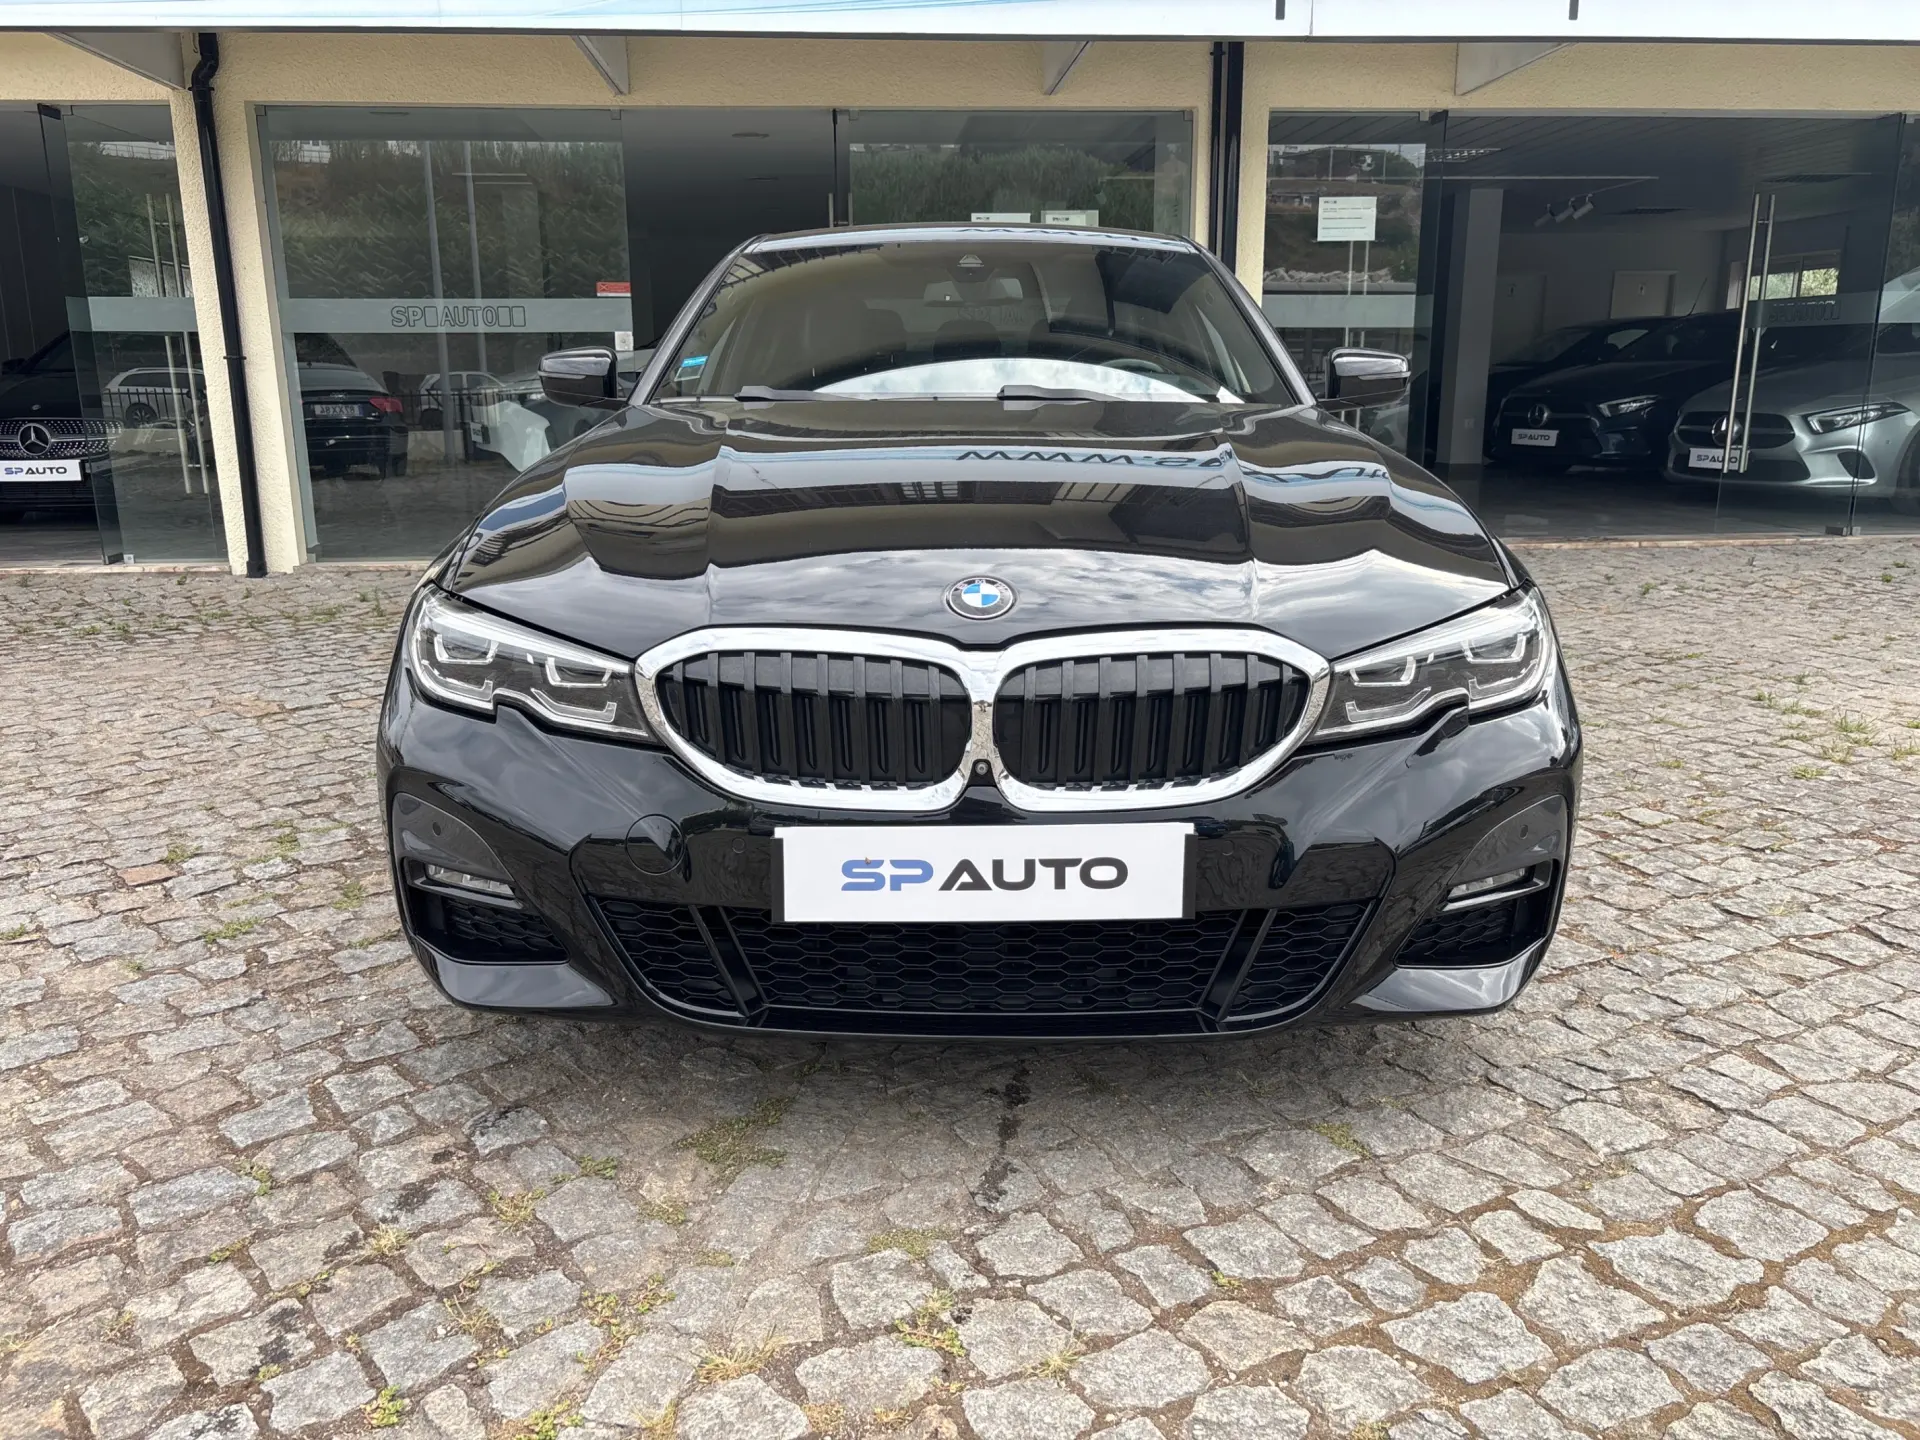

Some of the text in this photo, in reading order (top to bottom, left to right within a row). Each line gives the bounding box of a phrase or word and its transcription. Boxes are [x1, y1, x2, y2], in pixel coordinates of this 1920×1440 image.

[1528, 433, 1551, 441] AUTO
[1696, 454, 1738, 464] SP AUO
[4, 466, 68, 475] SP AUTO
[841, 857, 1128, 891] SP AUTO
